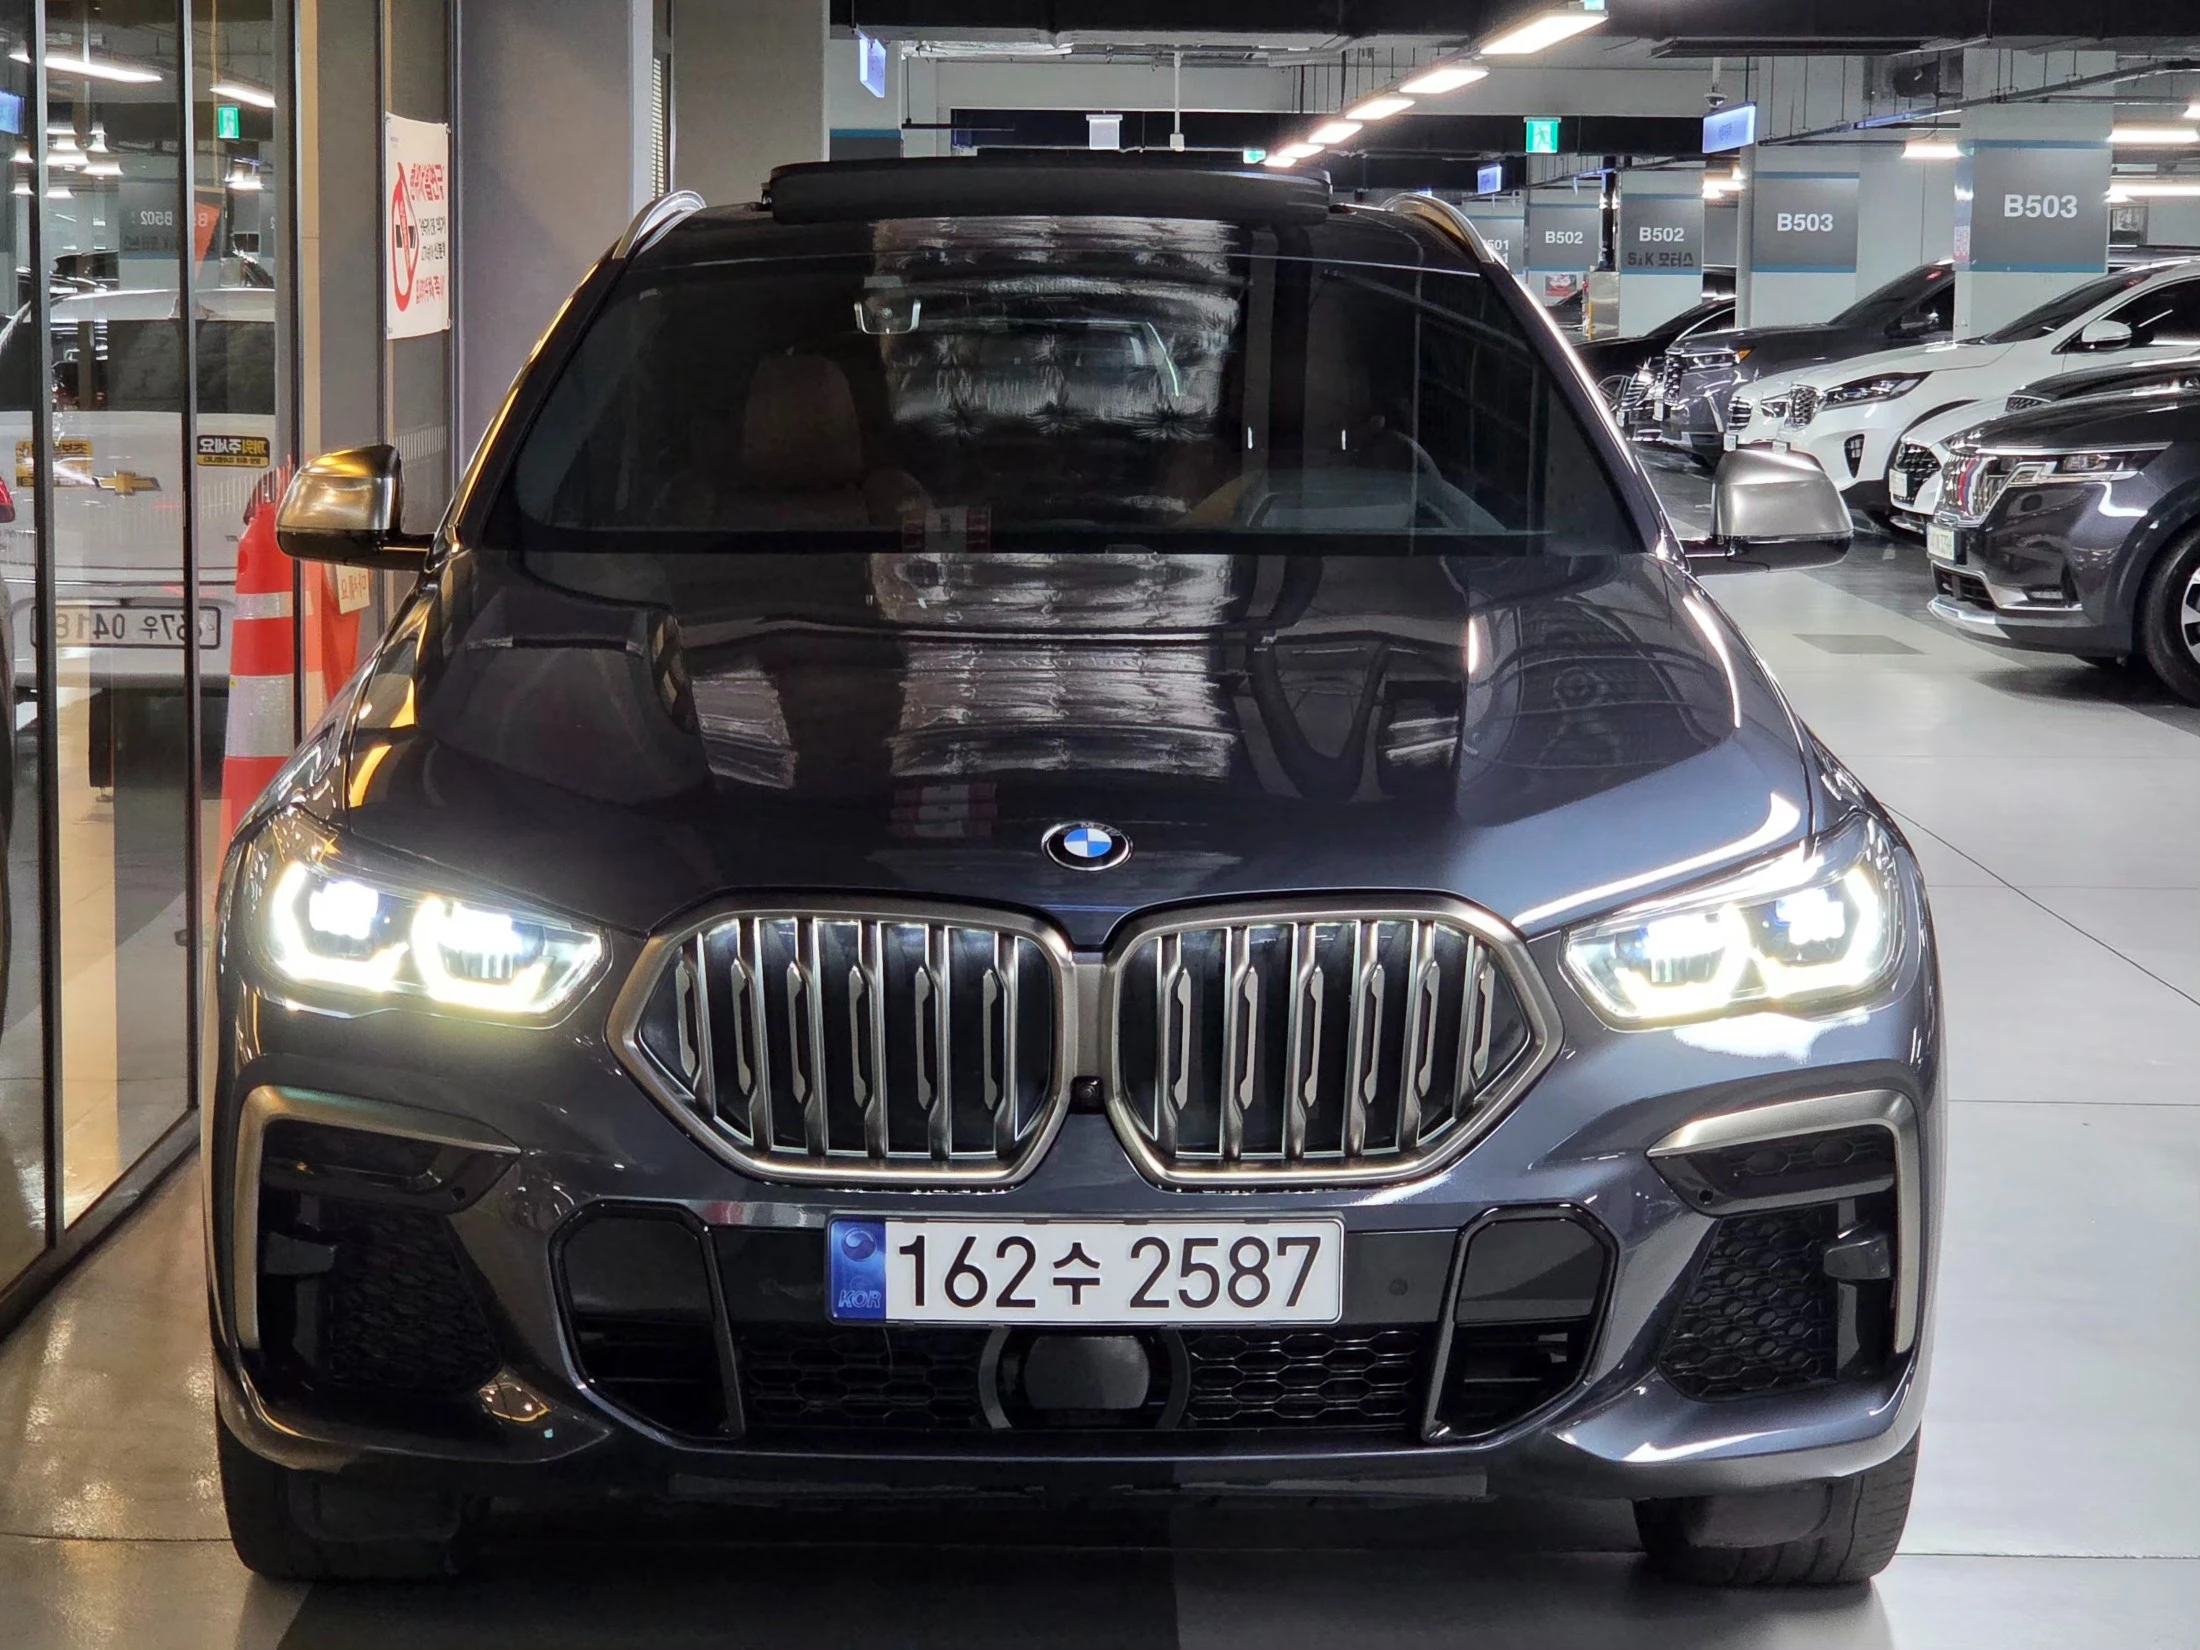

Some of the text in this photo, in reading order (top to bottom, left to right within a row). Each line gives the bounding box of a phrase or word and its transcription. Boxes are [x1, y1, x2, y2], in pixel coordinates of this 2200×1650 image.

[2003, 193, 2078, 218] B503
[1776, 212, 1833, 232] B503
[1545, 230, 1584, 244] B502
[1639, 226, 1685, 242] B502
[1482, 239, 1509, 251] 501
[1658, 251, 1695, 268] 모터스
[899, 1234, 1322, 1309] 162수 2587
[837, 1288, 883, 1309] KOR
